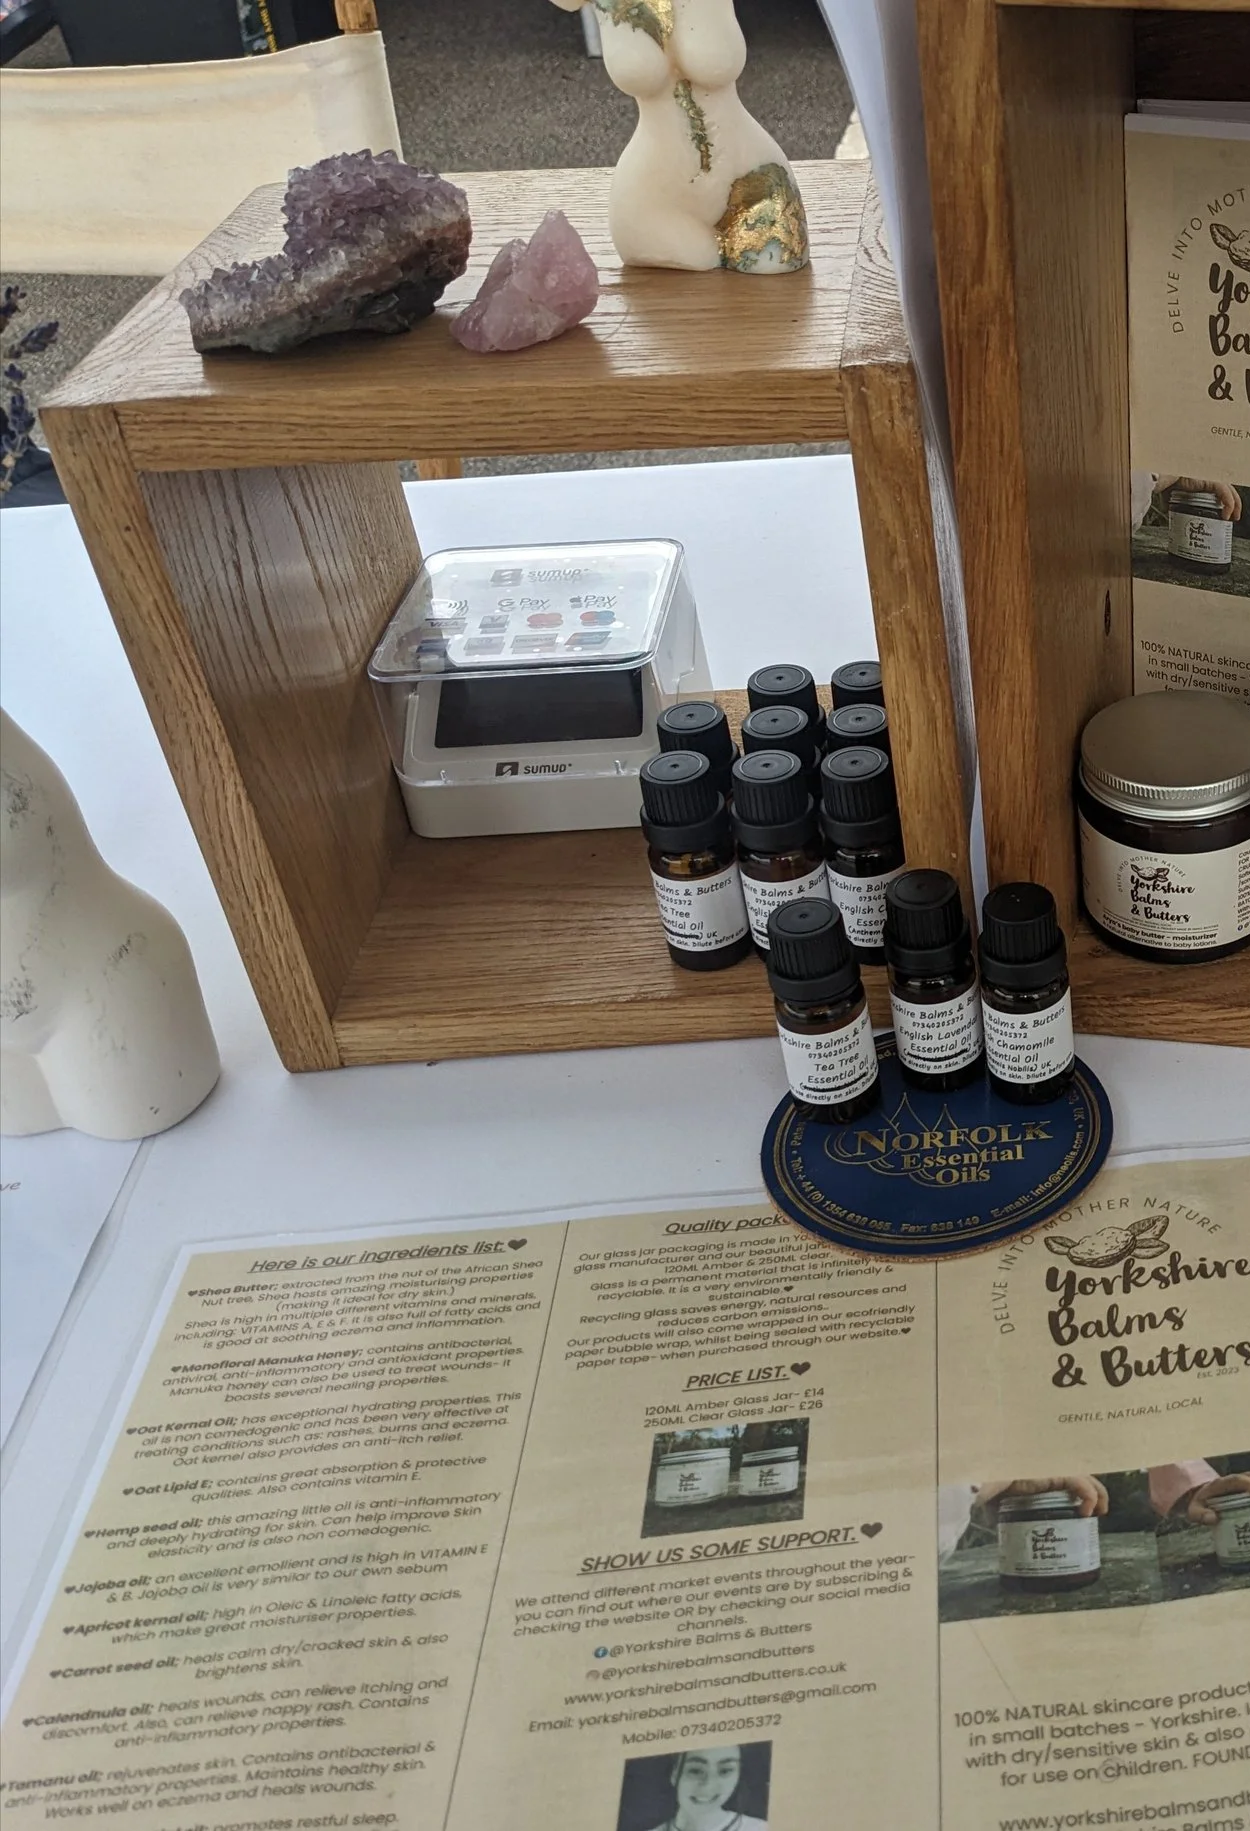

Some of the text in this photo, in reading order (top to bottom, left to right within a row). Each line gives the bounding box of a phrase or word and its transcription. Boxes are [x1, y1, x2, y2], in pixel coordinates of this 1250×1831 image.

[1172, 217, 1203, 260] INTO
[1168, 271, 1184, 333] DELVE
[1208, 364, 1234, 401] &
[1211, 426, 1244, 439] GENTLE,
[1141, 640, 1166, 654] 100%
[1168, 646, 1214, 664] NATURAL
[1148, 656, 1238, 681] in small batches
[1146, 670, 1168, 682] with
[1171, 673, 1240, 694] dry/sensitive
[1130, 875, 1196, 894] Yorkshire
[1130, 890, 1171, 908] Balms
[1130, 904, 1140, 916] &
[1144, 906, 1191, 922] Butters
[1122, 923, 1217, 940] baby butter moisturizer
[920, 1009, 953, 1020] Balms
[988, 1006, 1065, 1029] Balms & Butters
[816, 1035, 849, 1049] Balms
[900, 1027, 933, 1041] English
[910, 1032, 971, 1053] Essential Oil
[997, 1036, 1054, 1050] Chamomile
[808, 1055, 868, 1083] Essential Oil
[839, 1053, 859, 1067] Tree
[1025, 1054, 1038, 1063] Oil
[852, 1120, 1054, 1156] NORFOLK
[901, 1145, 1024, 1170] Essential
[934, 1167, 990, 1186] Oils
[250, 1258, 298, 1273] Here
[300, 1256, 318, 1269] is
[322, 1253, 356, 1266] our
[359, 1244, 468, 1264] ingredients
[992, 1197, 1221, 1334] DELVE INTO MOTHER NATURE
[1048, 1304, 1187, 1346] Balms
[685, 1366, 789, 1390] PRICE LIST.
[1052, 1353, 1087, 1388] &
[645, 1387, 825, 1416] 120ML Amber Glass Jar- £14
[580, 1526, 857, 1573] SHOW US SOME SUPPORT.
[954, 1709, 1000, 1728] 100%
[1004, 1702, 1089, 1721] NATURAL
[1092, 1696, 1174, 1715] skincare
[622, 1714, 782, 1745] Mobile: 07340205372
[1000, 1771, 1027, 1787] for
[1032, 1770, 1068, 1784] use
[1074, 1768, 1098, 1781] on
[1104, 1758, 1188, 1780] children.
